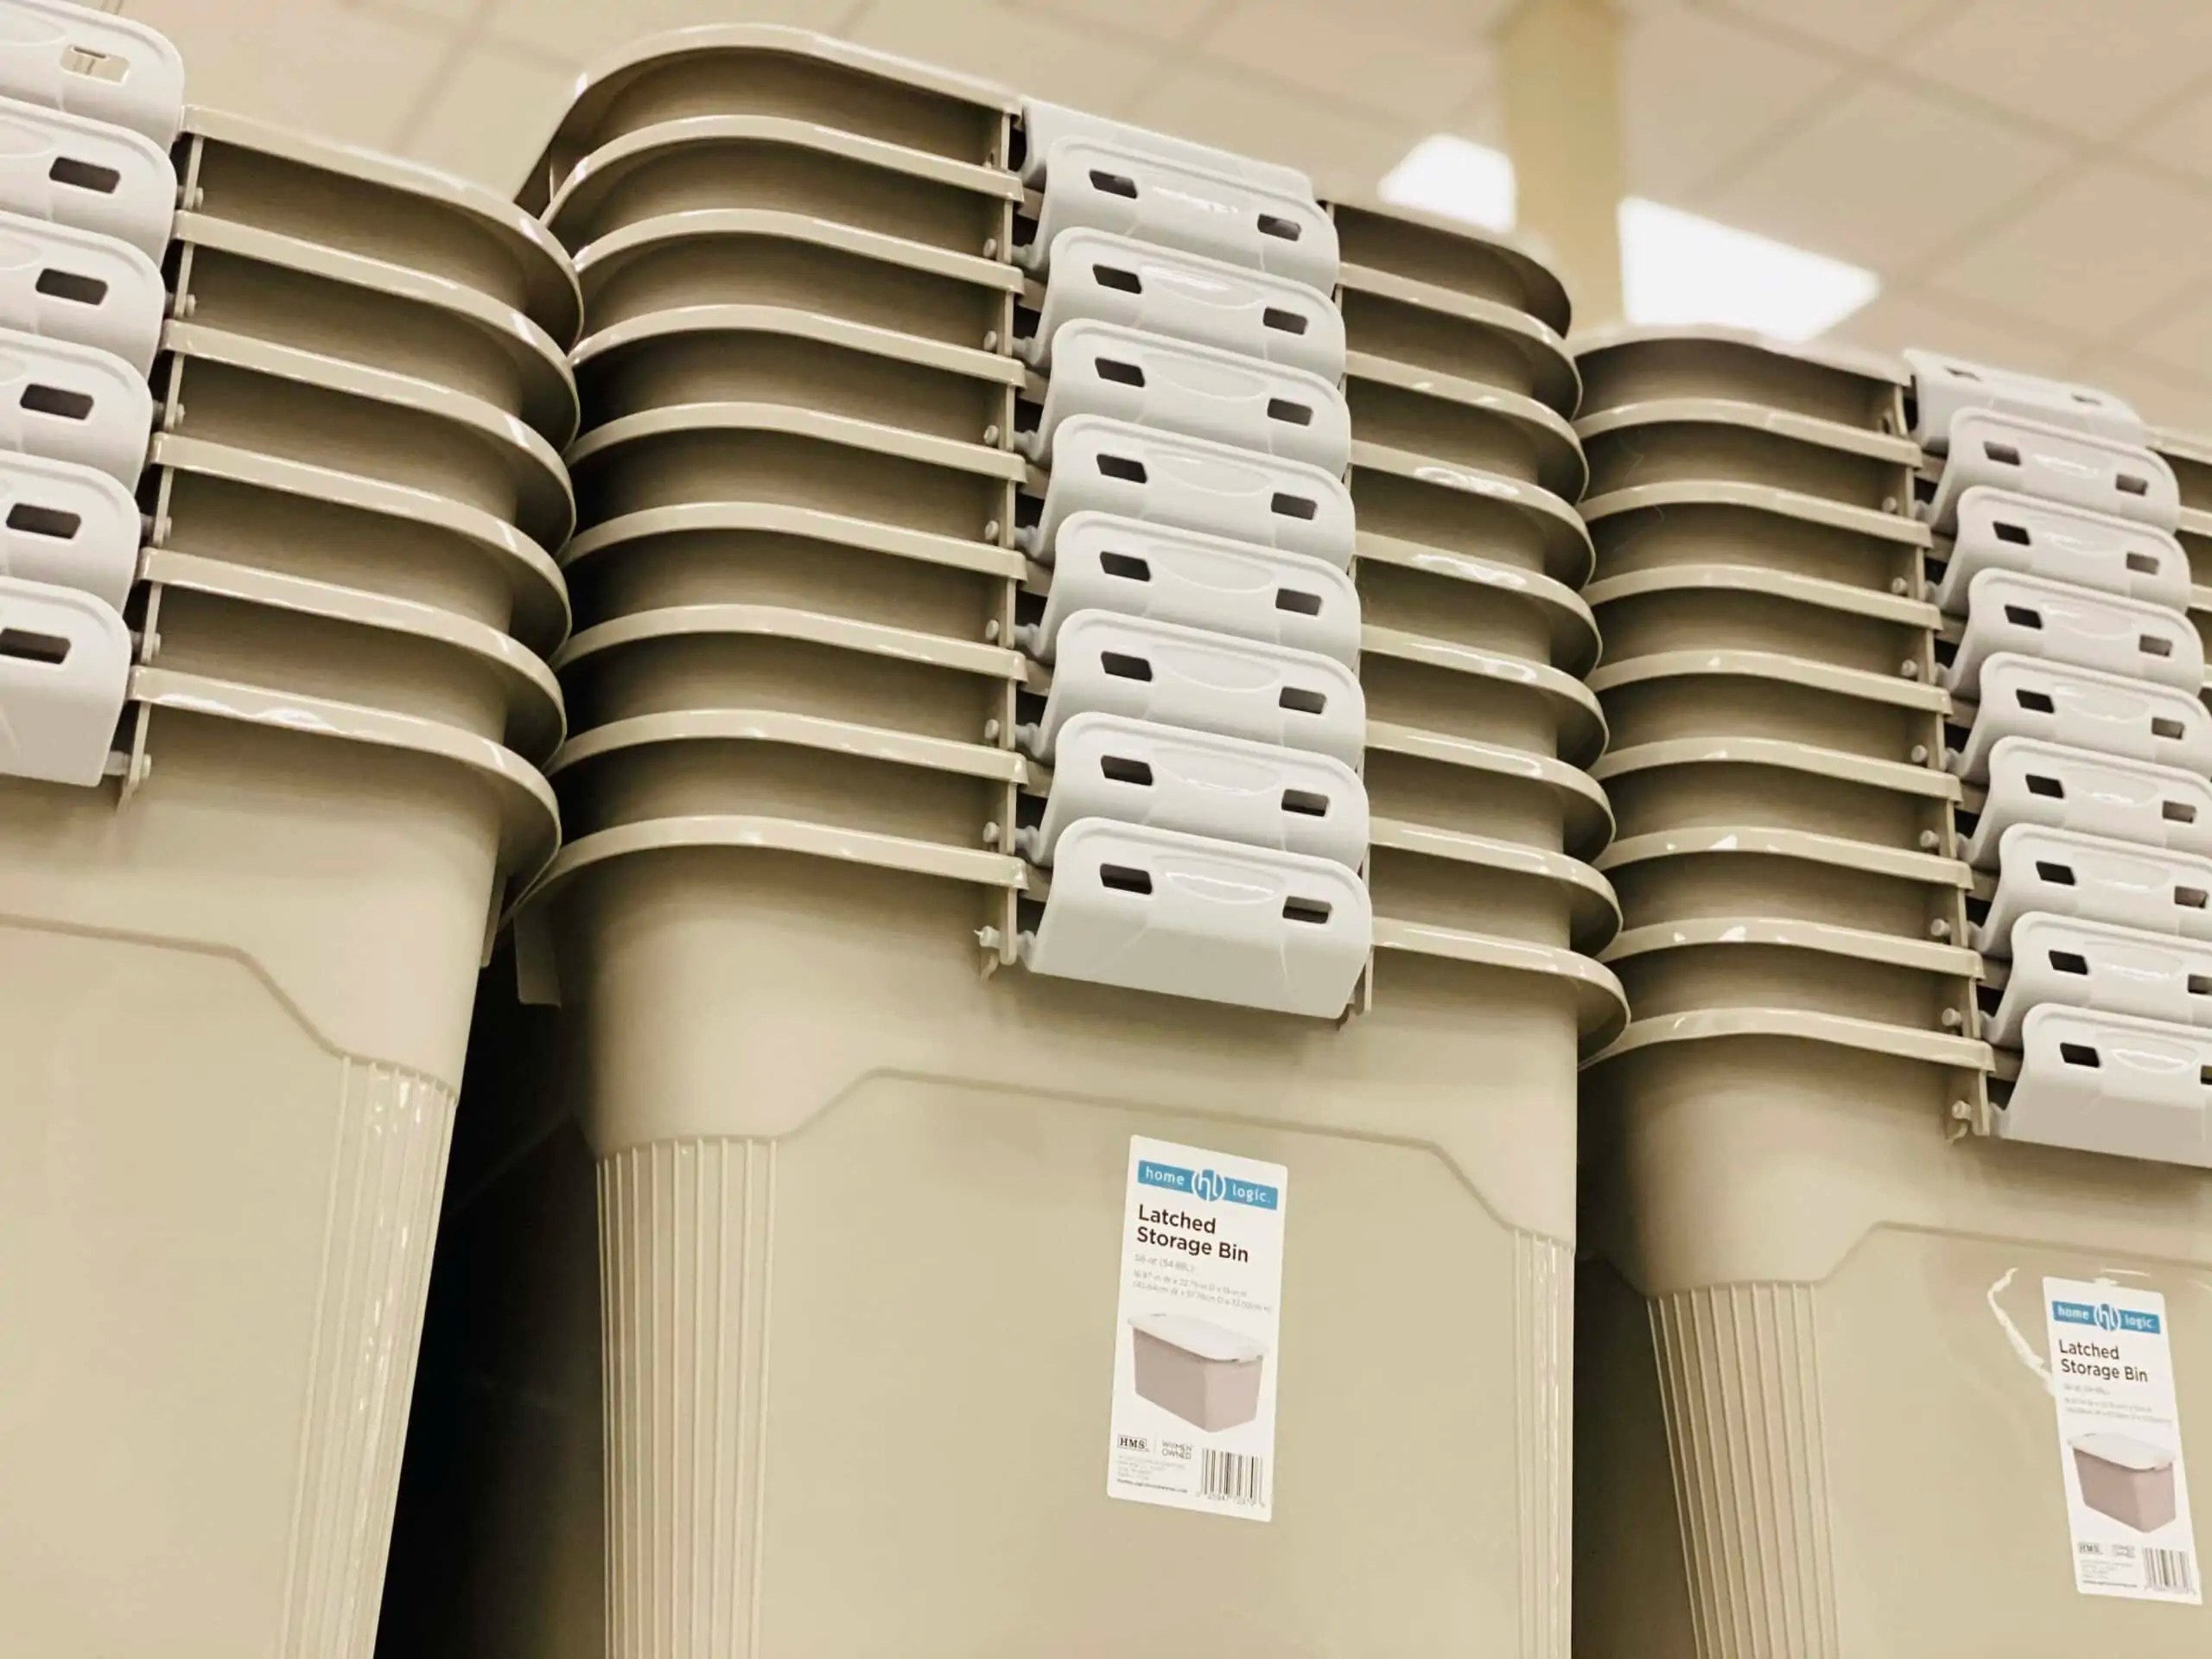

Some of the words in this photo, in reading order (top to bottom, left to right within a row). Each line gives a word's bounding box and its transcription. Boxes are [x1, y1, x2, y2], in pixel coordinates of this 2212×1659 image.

[1145, 1166, 1185, 1185] home
[1138, 1204, 1217, 1234] Latched
[1137, 1226, 1212, 1256] Storage
[1218, 1242, 1249, 1263] Bin
[2057, 1305, 2089, 1320] home
[2126, 1314, 2153, 1329] logic
[2058, 1338, 2120, 1360] Latched
[2061, 1358, 2120, 1381] Storage
[2124, 1366, 2148, 1382] Bin
[1120, 1437, 1145, 1450] HMS
